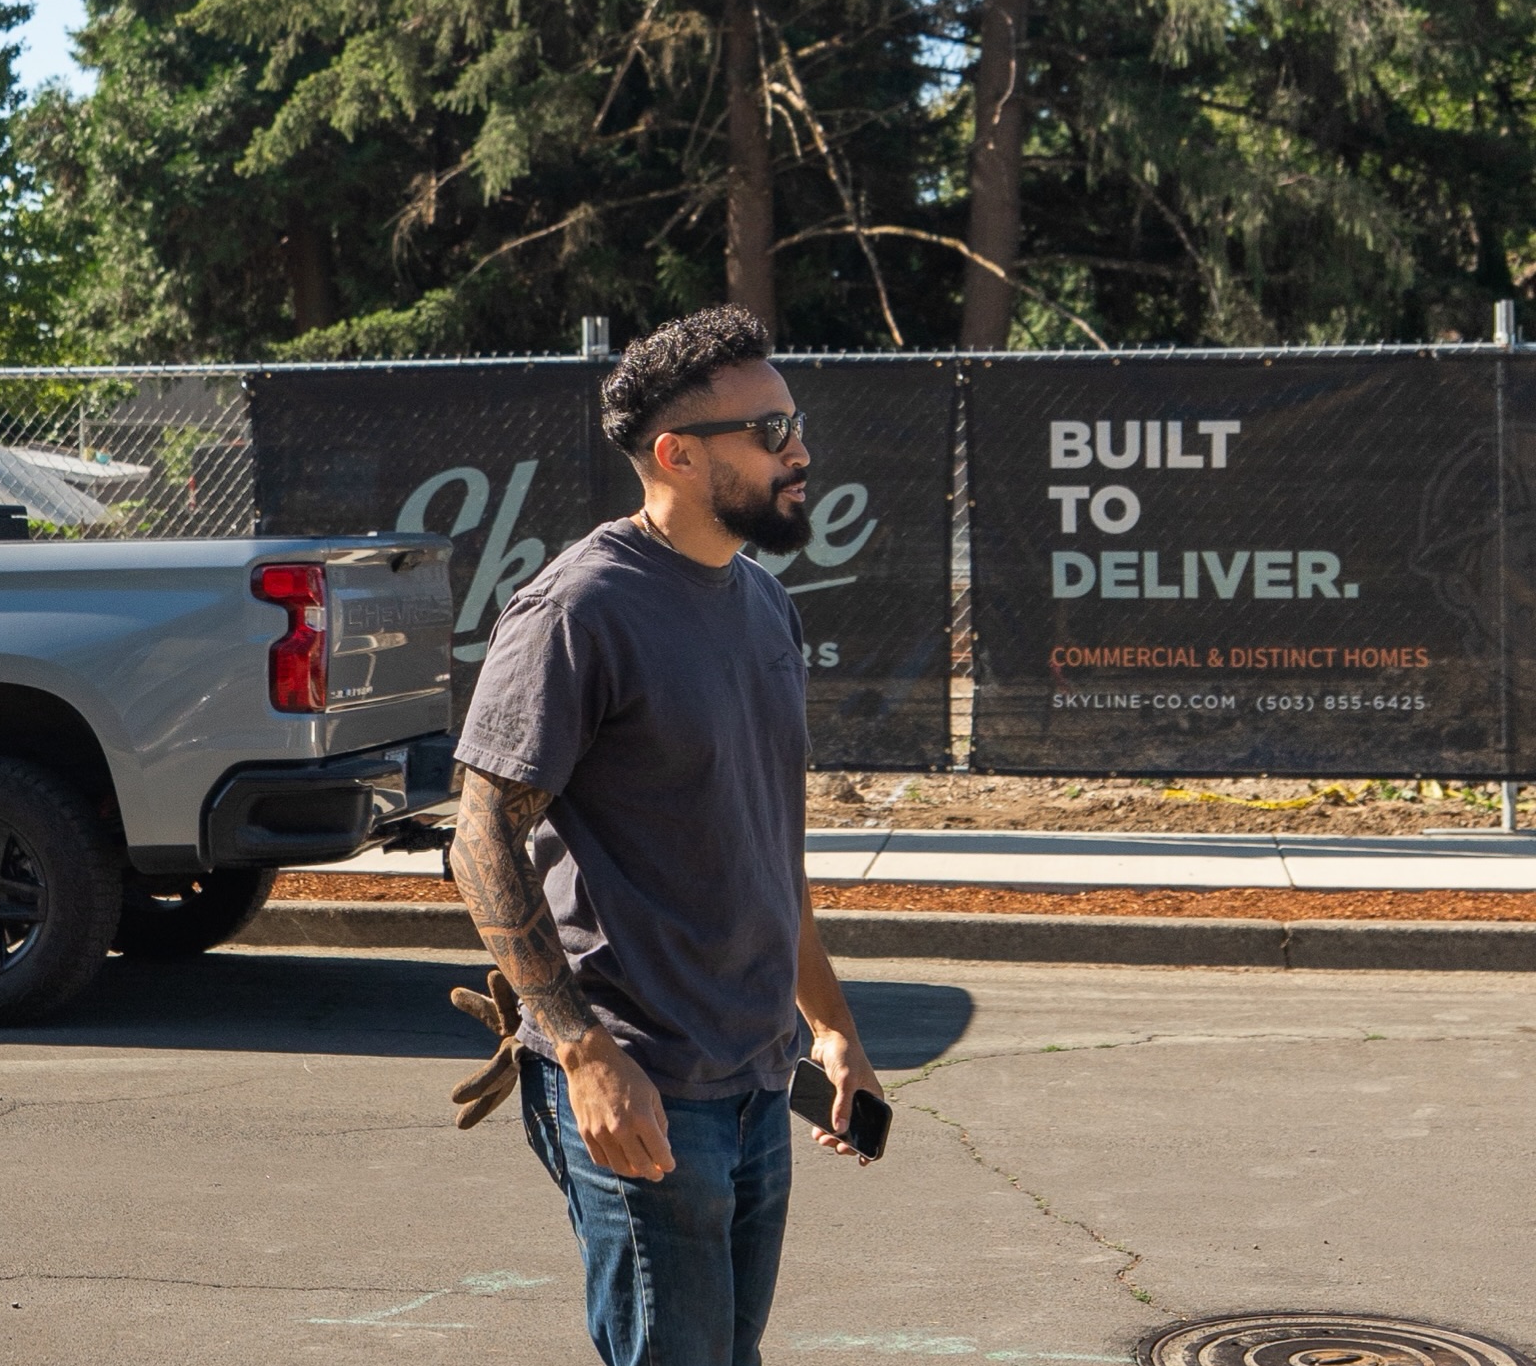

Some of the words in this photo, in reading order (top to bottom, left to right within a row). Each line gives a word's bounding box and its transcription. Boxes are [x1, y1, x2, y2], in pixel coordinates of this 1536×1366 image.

[1050, 420, 1241, 469] BUILT
[1048, 485, 1142, 534] TO
[1052, 550, 1359, 599] DELIVER.
[1050, 647, 1202, 669] COMMERCIAL
[1207, 647, 1225, 669] &
[1230, 647, 1337, 669] DISTINCT
[1344, 647, 1429, 669] HOMES
[1052, 694, 1236, 710] SKYLINE-CO.COM
[1256, 695, 1315, 712] (503)
[1324, 695, 1426, 711] 855-6425
